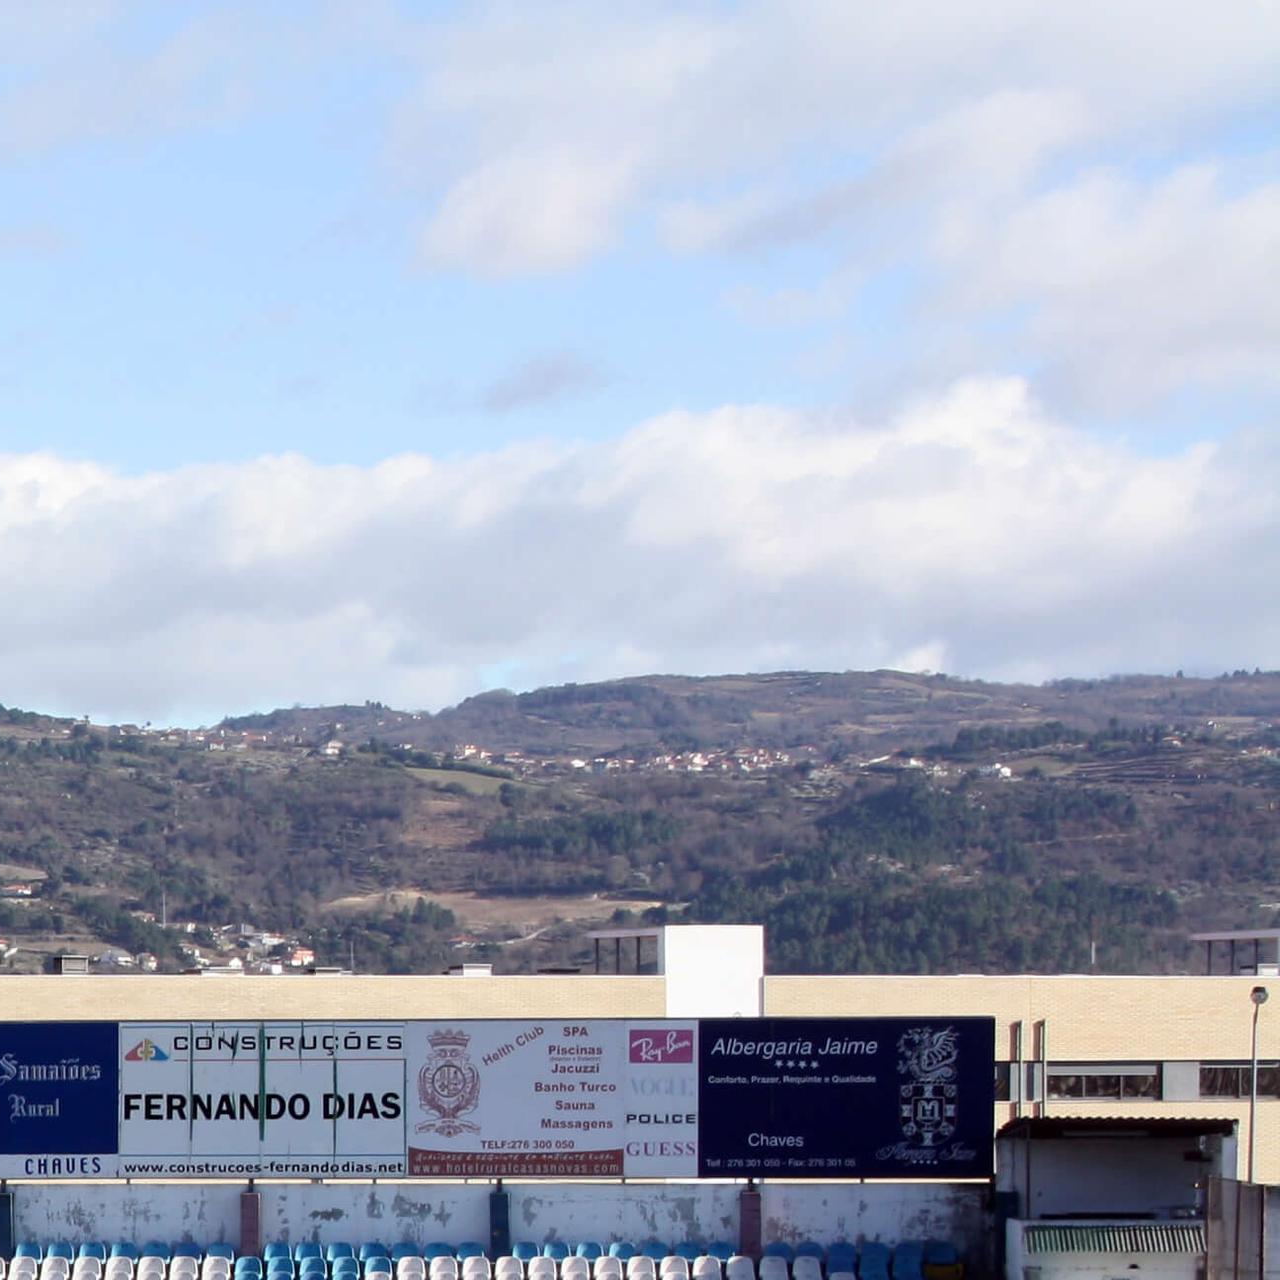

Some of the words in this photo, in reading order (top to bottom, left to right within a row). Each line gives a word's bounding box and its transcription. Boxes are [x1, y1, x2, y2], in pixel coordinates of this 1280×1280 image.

[515, 1025, 545, 1048] Club
[563, 1026, 588, 1037] SPA
[173, 1031, 403, 1056] CONSTRUÇÕES
[710, 1037, 812, 1059] Albergaria
[818, 1038, 878, 1055] Jaime
[548, 1045, 603, 1056] Piscinas
[551, 1063, 600, 1074] Jacuzzi
[831, 1075, 877, 1084] Qualidade
[535, 1082, 575, 1093] Banho
[580, 1082, 616, 1093] Turco
[8, 1093, 60, 1124] Rural
[124, 1093, 310, 1120] FERNANDO
[322, 1092, 401, 1120] DIAS
[555, 1100, 595, 1111] Sauna
[541, 1119, 613, 1131] Massagens
[626, 1114, 696, 1124] POLICE
[532, 1140, 552, 1149] 300
[555, 1140, 575, 1149] 050
[748, 1132, 804, 1147] Chaves
[626, 1141, 695, 1157] GUESS
[25, 1157, 101, 1174] CHAVES
[124, 1160, 403, 1175] www.construcoes-fernandodias.net
